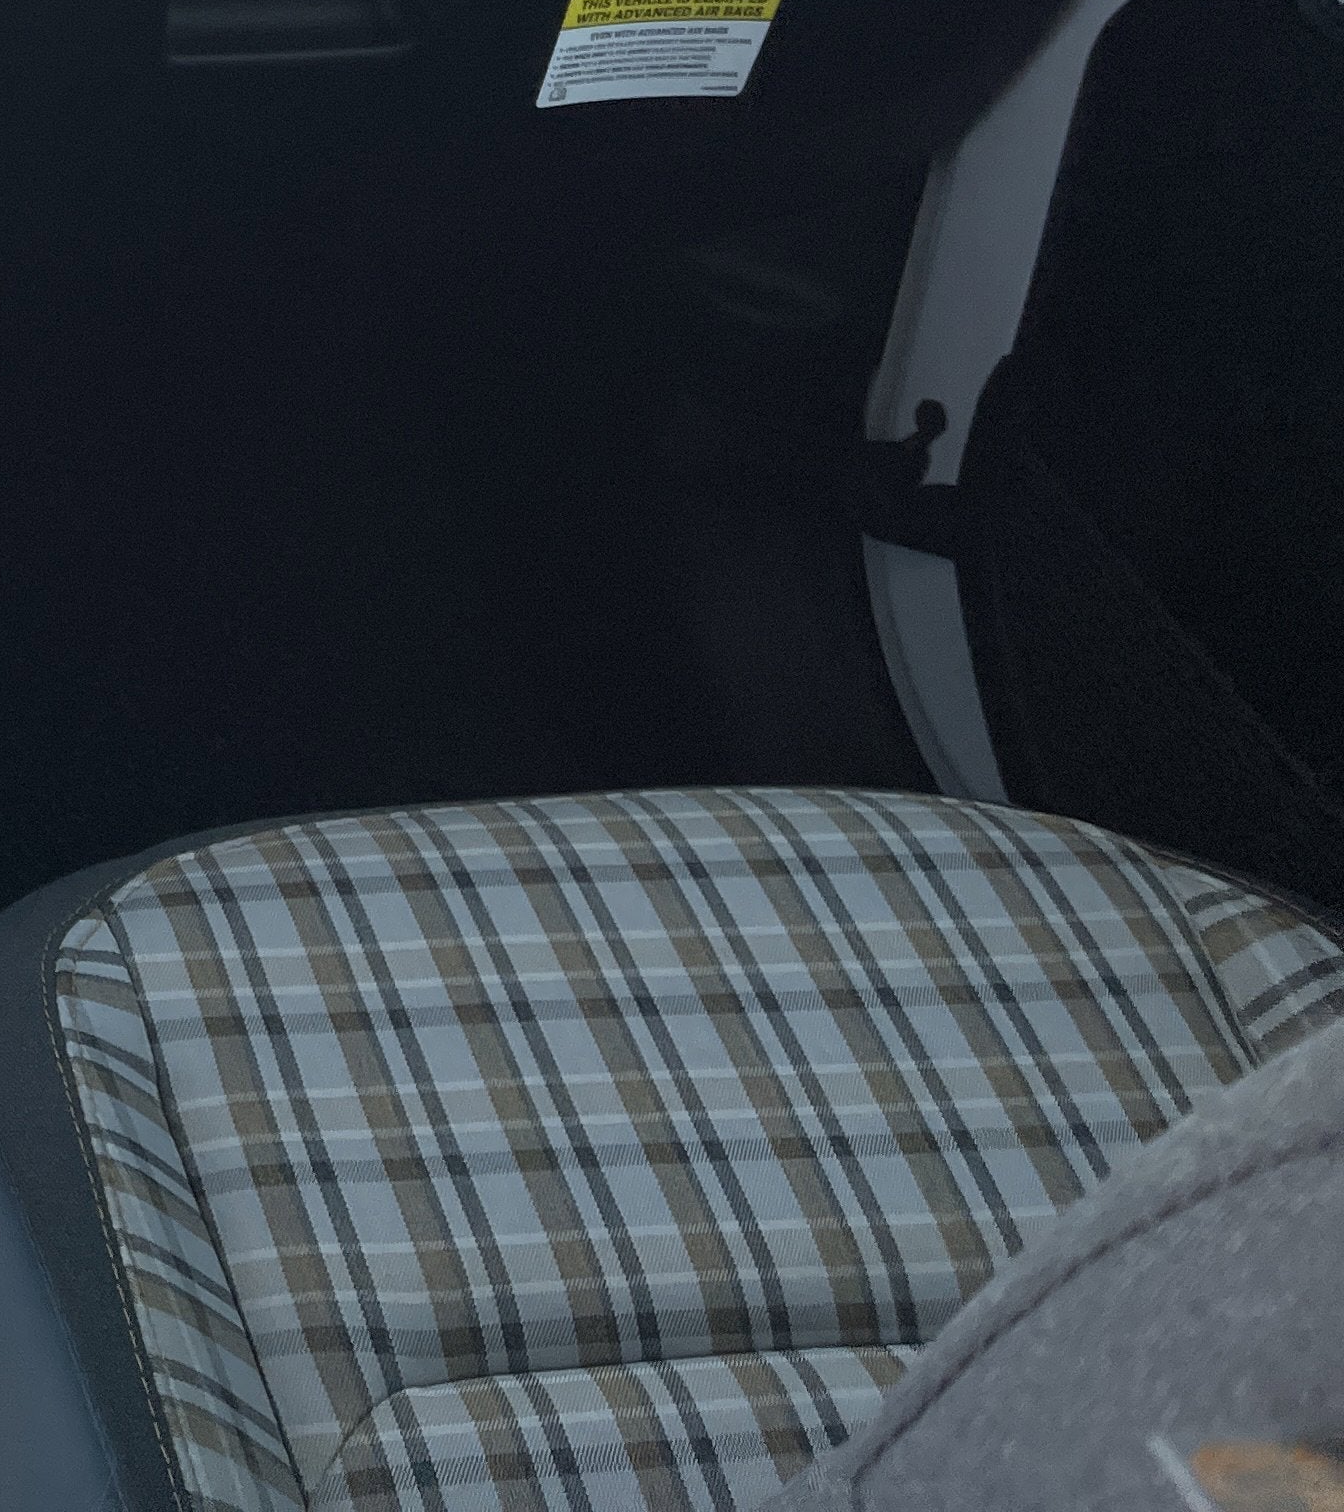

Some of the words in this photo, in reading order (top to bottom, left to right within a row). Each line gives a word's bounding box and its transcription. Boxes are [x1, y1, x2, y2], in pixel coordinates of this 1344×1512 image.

[577, 13, 610, 24] WITH
[613, 8, 693, 19] ADVANCED
[698, 7, 718, 17] AIR
[724, 7, 763, 17] BAGS
